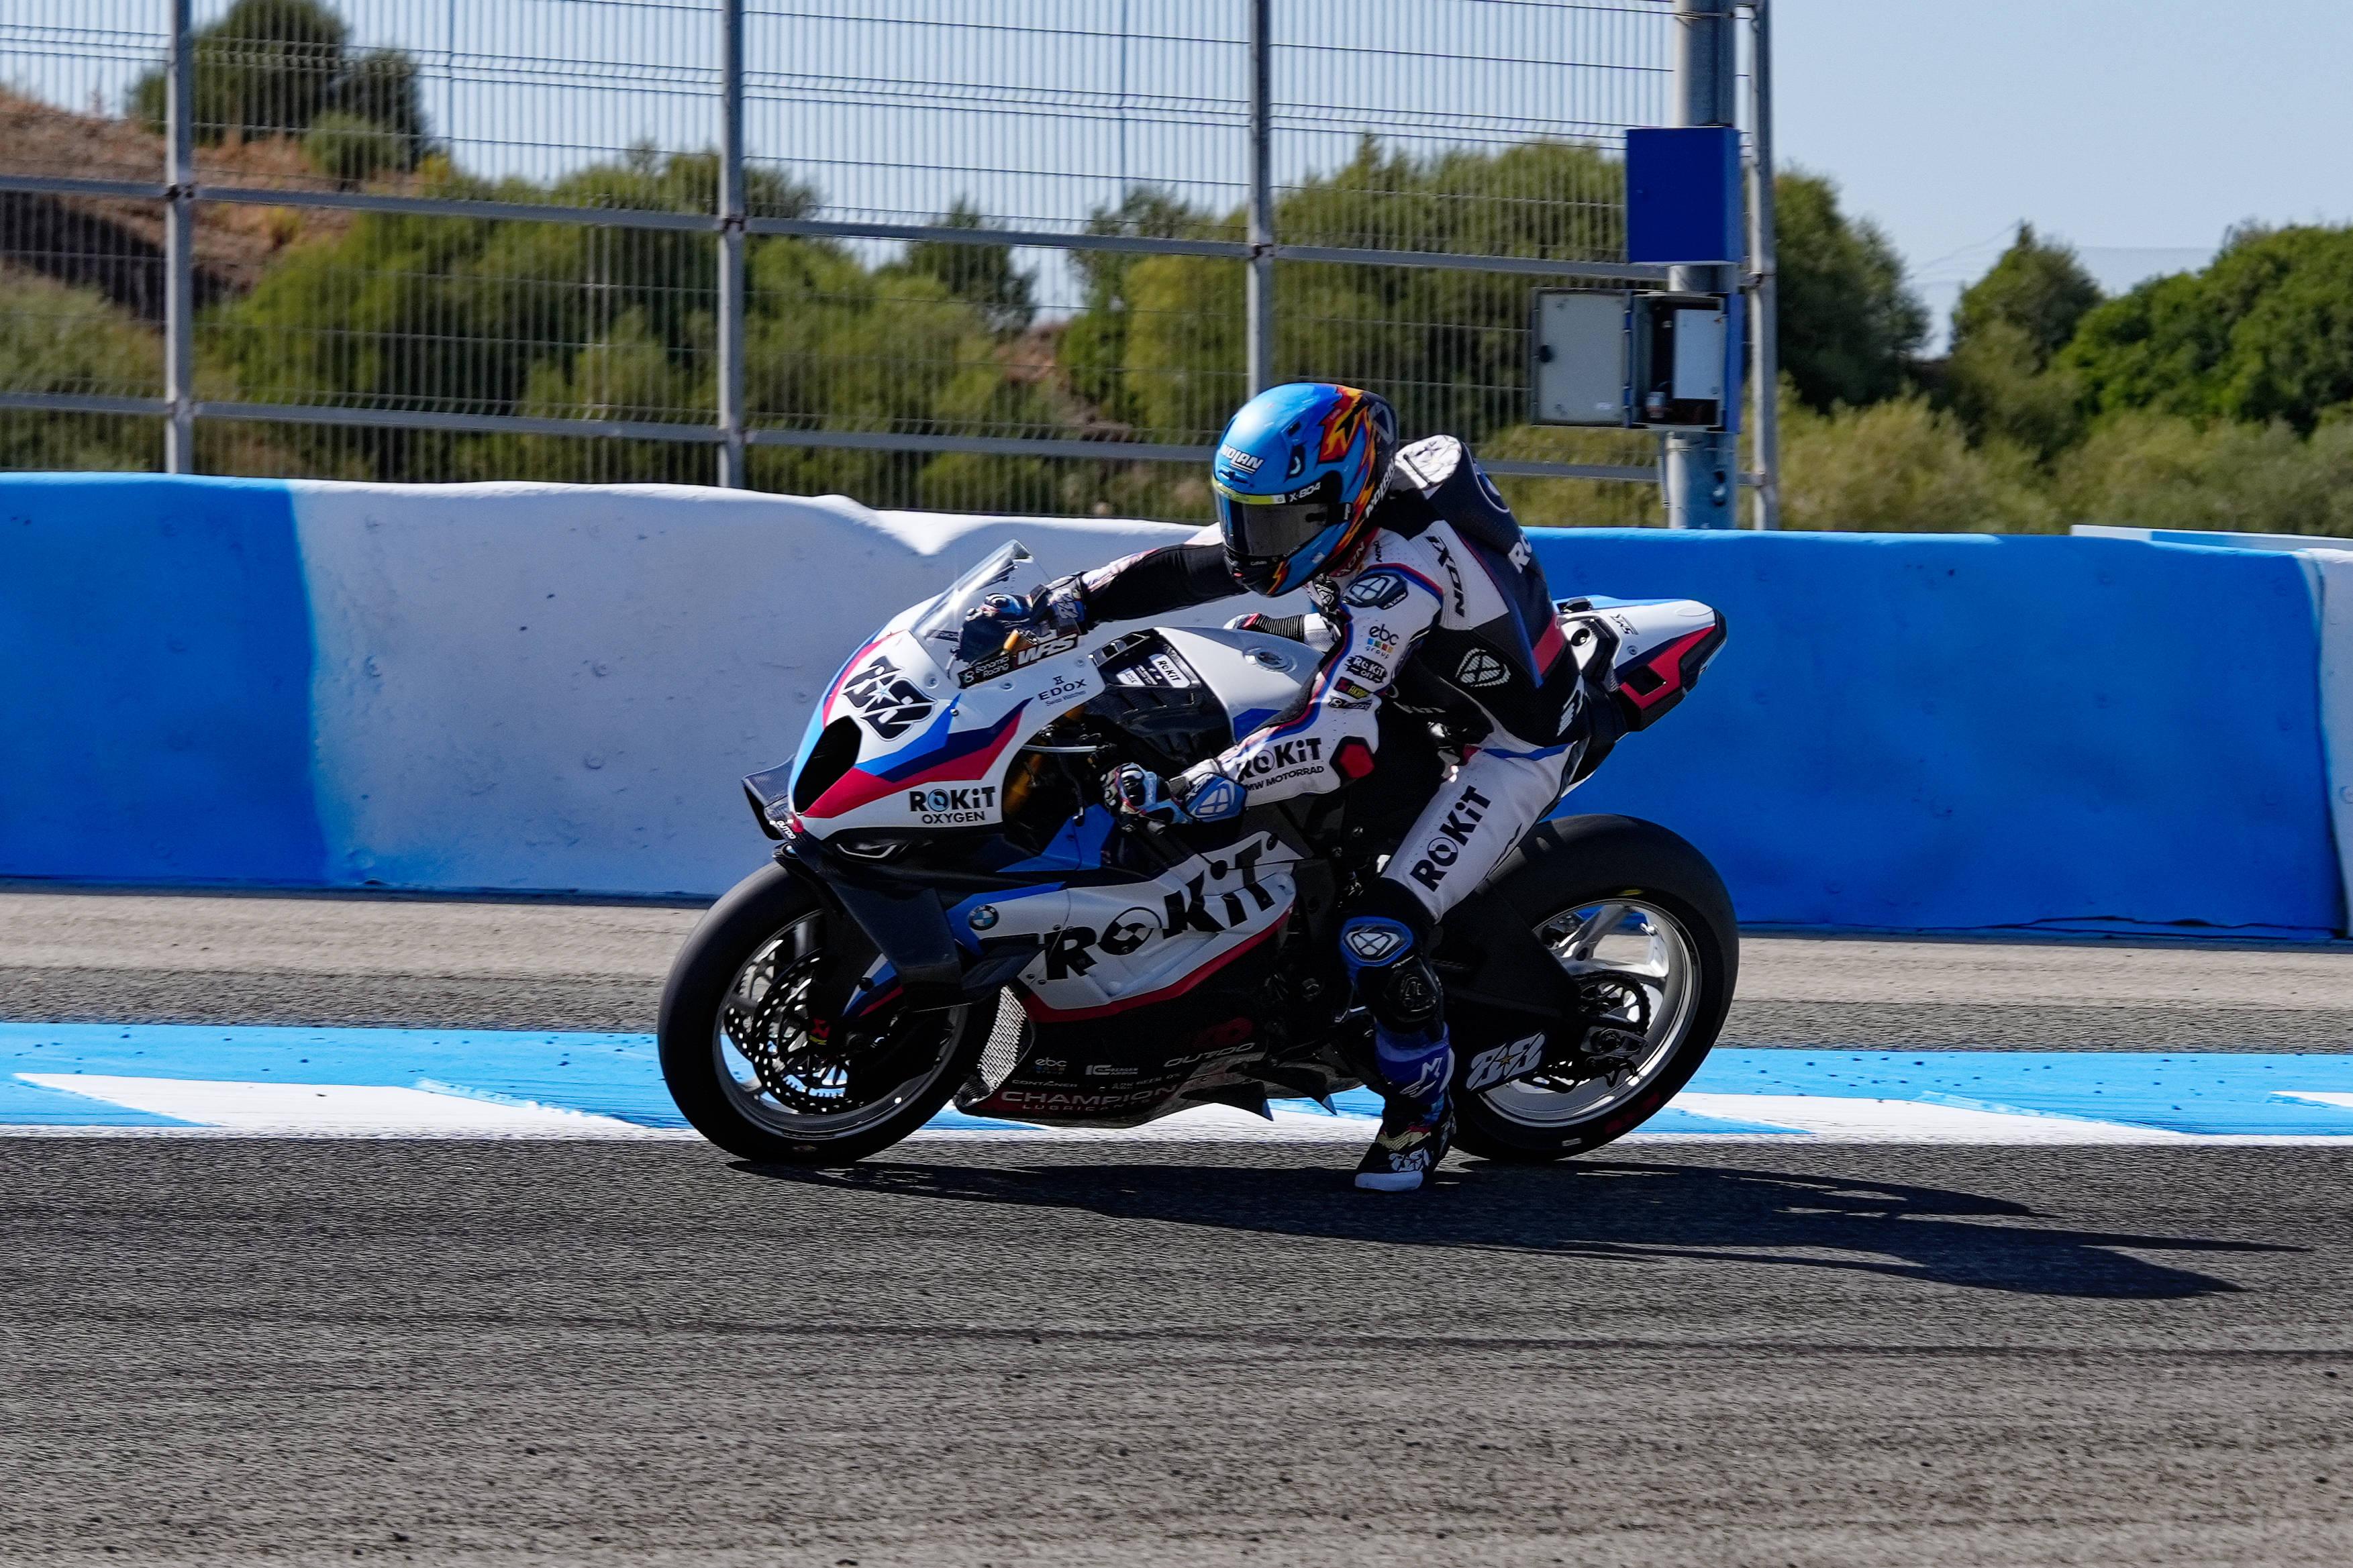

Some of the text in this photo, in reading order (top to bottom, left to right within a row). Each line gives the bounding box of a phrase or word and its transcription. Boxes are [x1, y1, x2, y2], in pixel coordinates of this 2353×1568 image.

[1220, 443, 1264, 470] NOLAN
[1289, 482, 1321, 502] X-804
[1369, 623, 1399, 645] ebc
[1017, 633, 1078, 666] WRS
[983, 664, 1009, 678] Racing
[1038, 679, 1088, 700] EDOX
[1245, 766, 1325, 792] MW MOTORRAD
[909, 786, 996, 813] ROKiT
[922, 811, 985, 825] OXYGEN
[1410, 785, 1491, 892] ROKiT
[1040, 839, 1276, 980] ROKiT
[1035, 1057, 1067, 1067] ebc
[1001, 1084, 1177, 1105] CHAMPION
